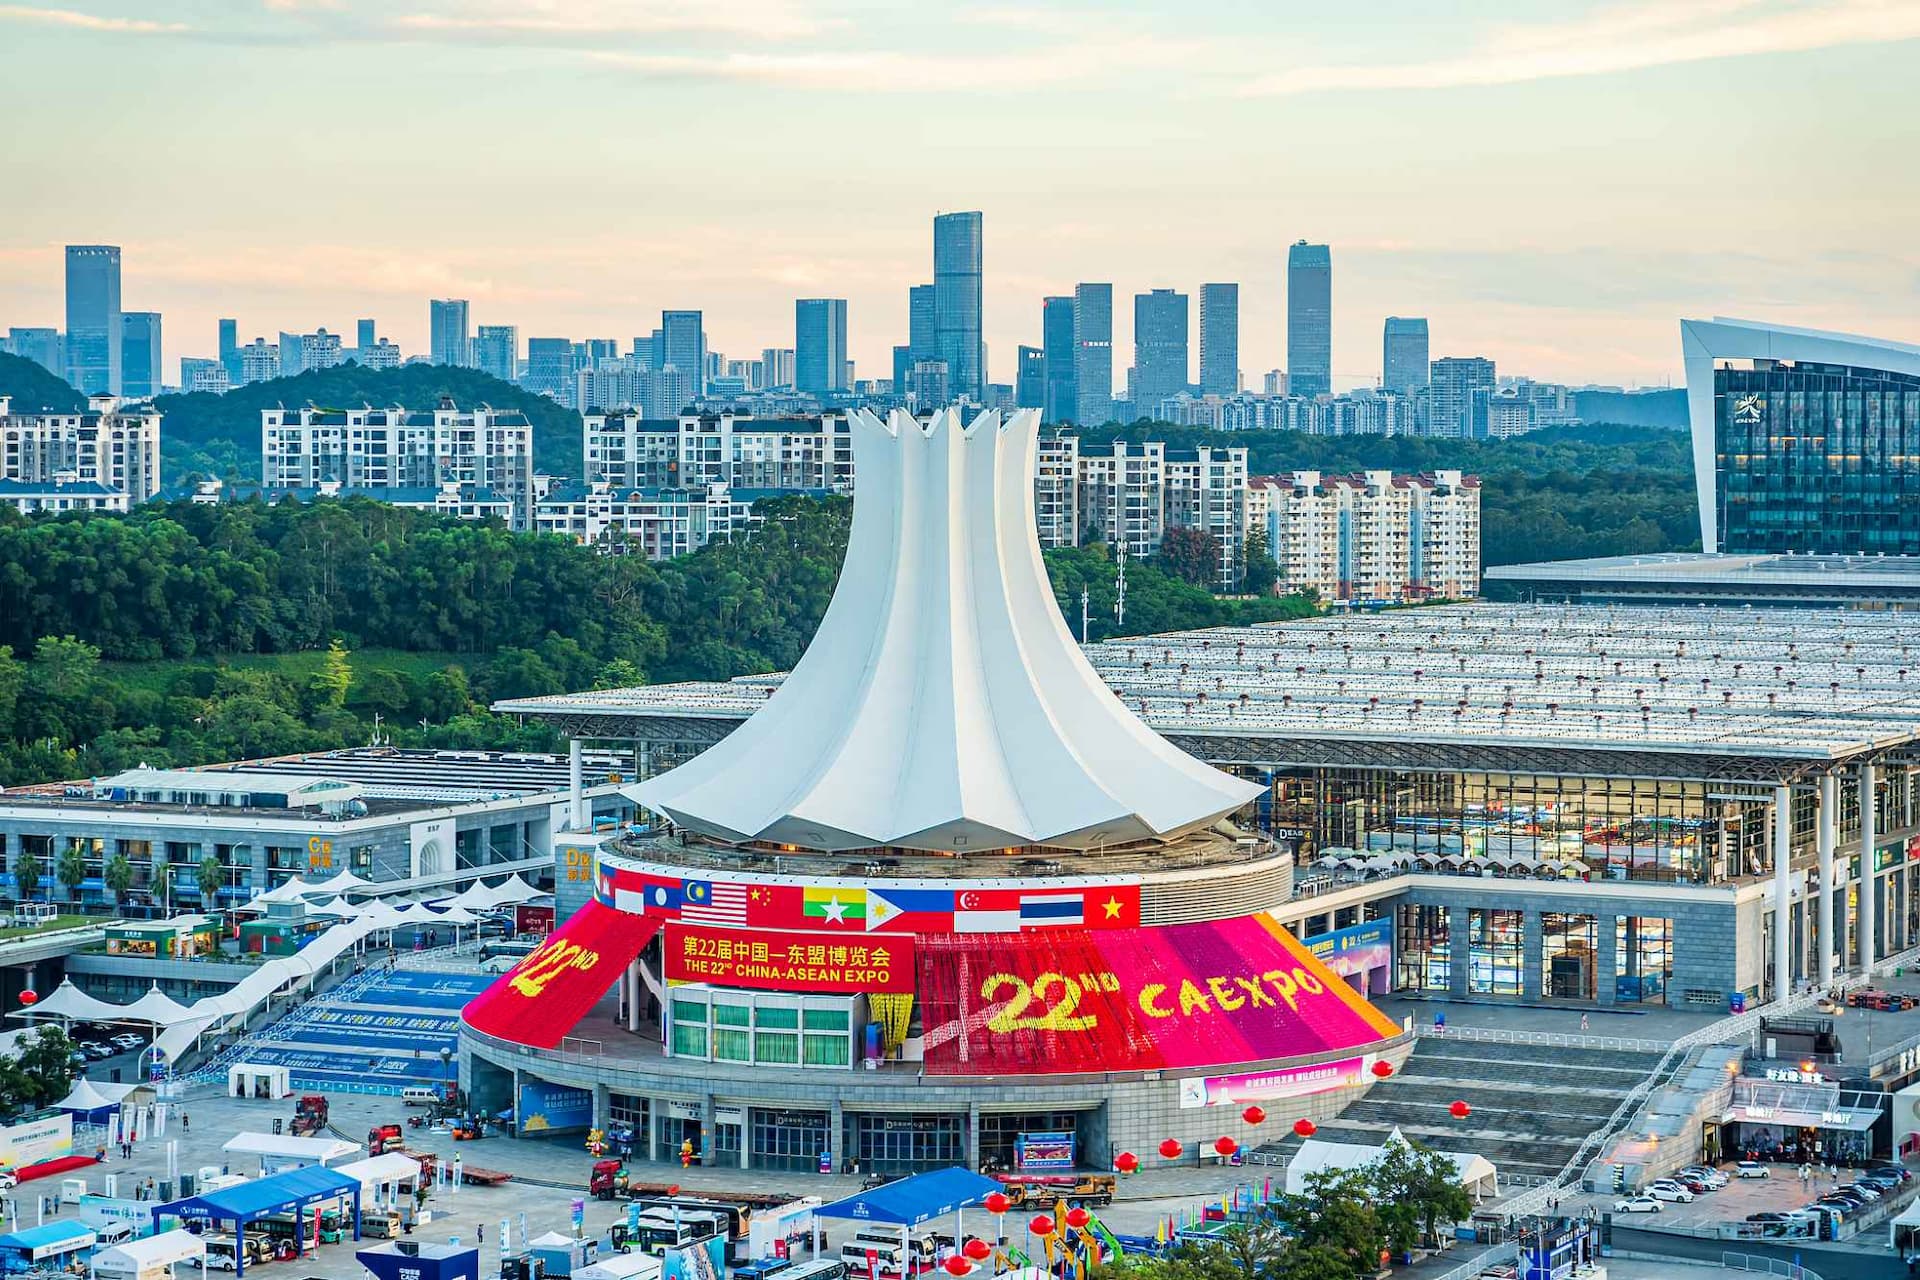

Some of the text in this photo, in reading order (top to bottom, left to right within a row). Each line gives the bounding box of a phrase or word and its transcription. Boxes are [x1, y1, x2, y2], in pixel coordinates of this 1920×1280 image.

[683, 935, 891, 968] 第22届中国—东盟博览会
[684, 959, 708, 973] THE
[735, 964, 841, 982] CHINA-ASEAN
[844, 969, 890, 983] EXPO
[981, 967, 1324, 1034] 22ND CAEXPO
